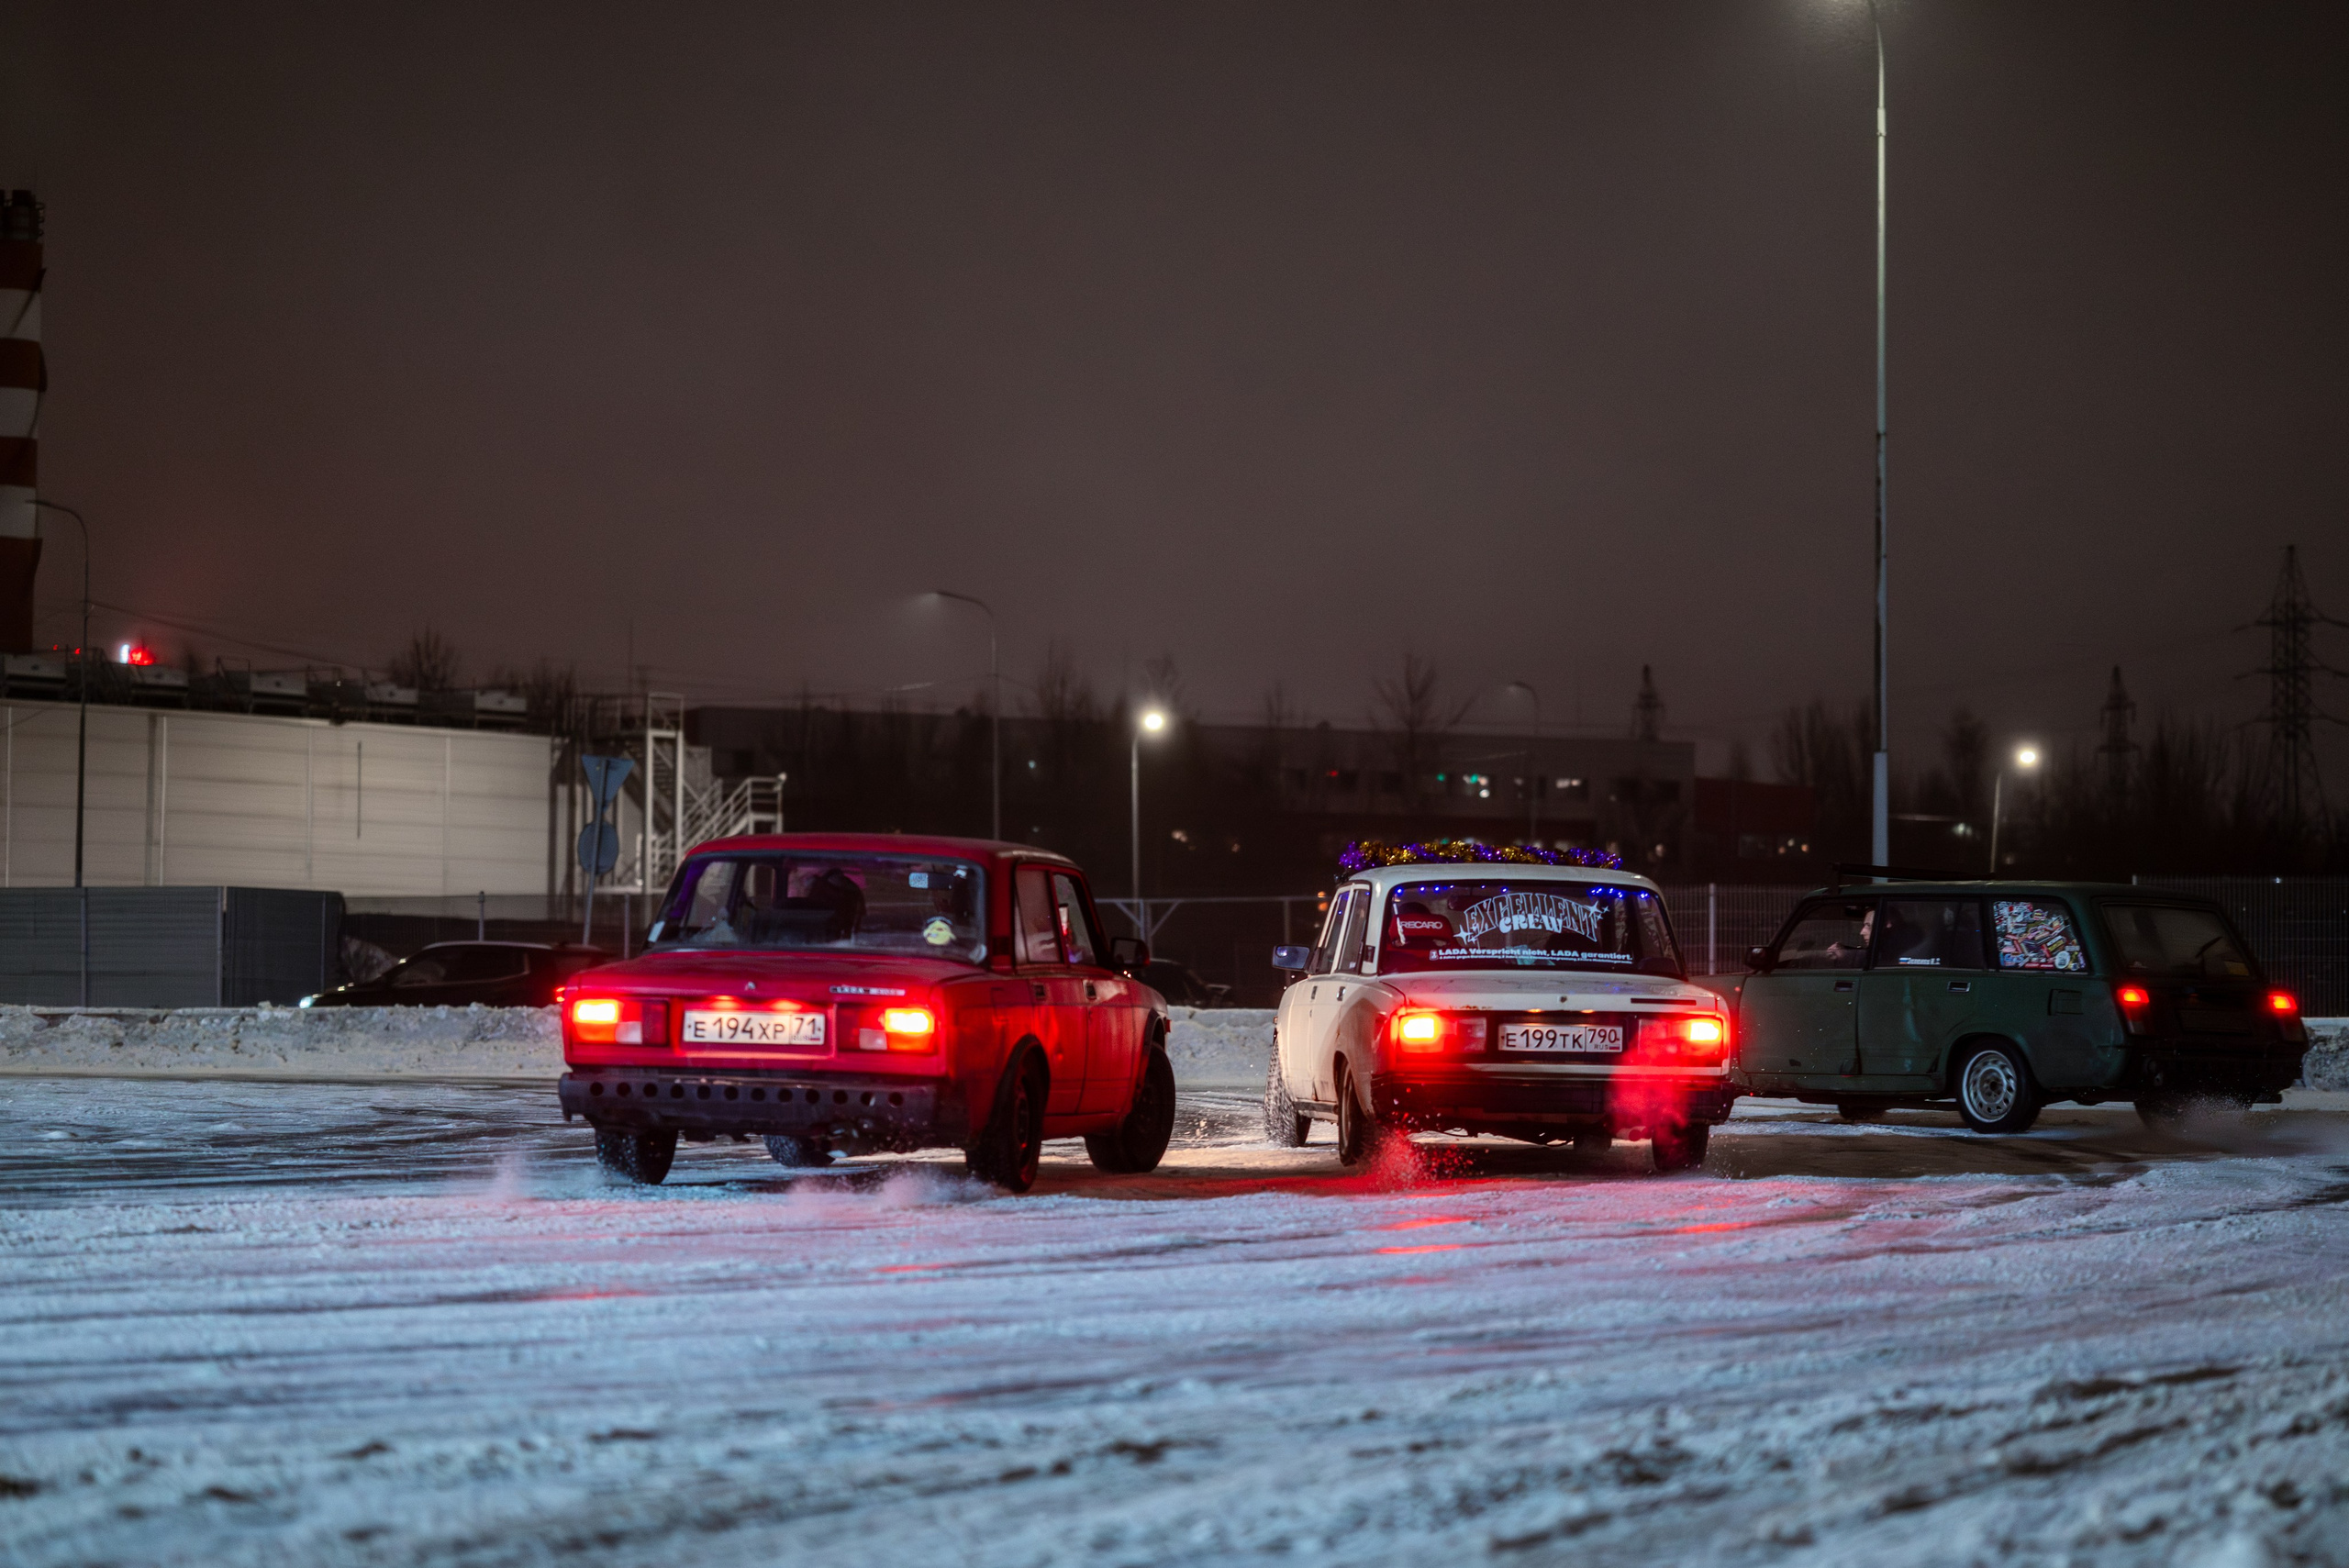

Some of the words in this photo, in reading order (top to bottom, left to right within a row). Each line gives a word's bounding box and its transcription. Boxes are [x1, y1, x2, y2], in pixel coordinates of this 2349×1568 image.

[1400, 920, 1443, 929] RECARO
[1463, 892, 1598, 942] EXCELLENT
[1498, 913, 1564, 934] CREW
[1438, 948, 1468, 956] LADA
[794, 1017, 816, 1035] 71
[1587, 1029, 1618, 1044] 790
